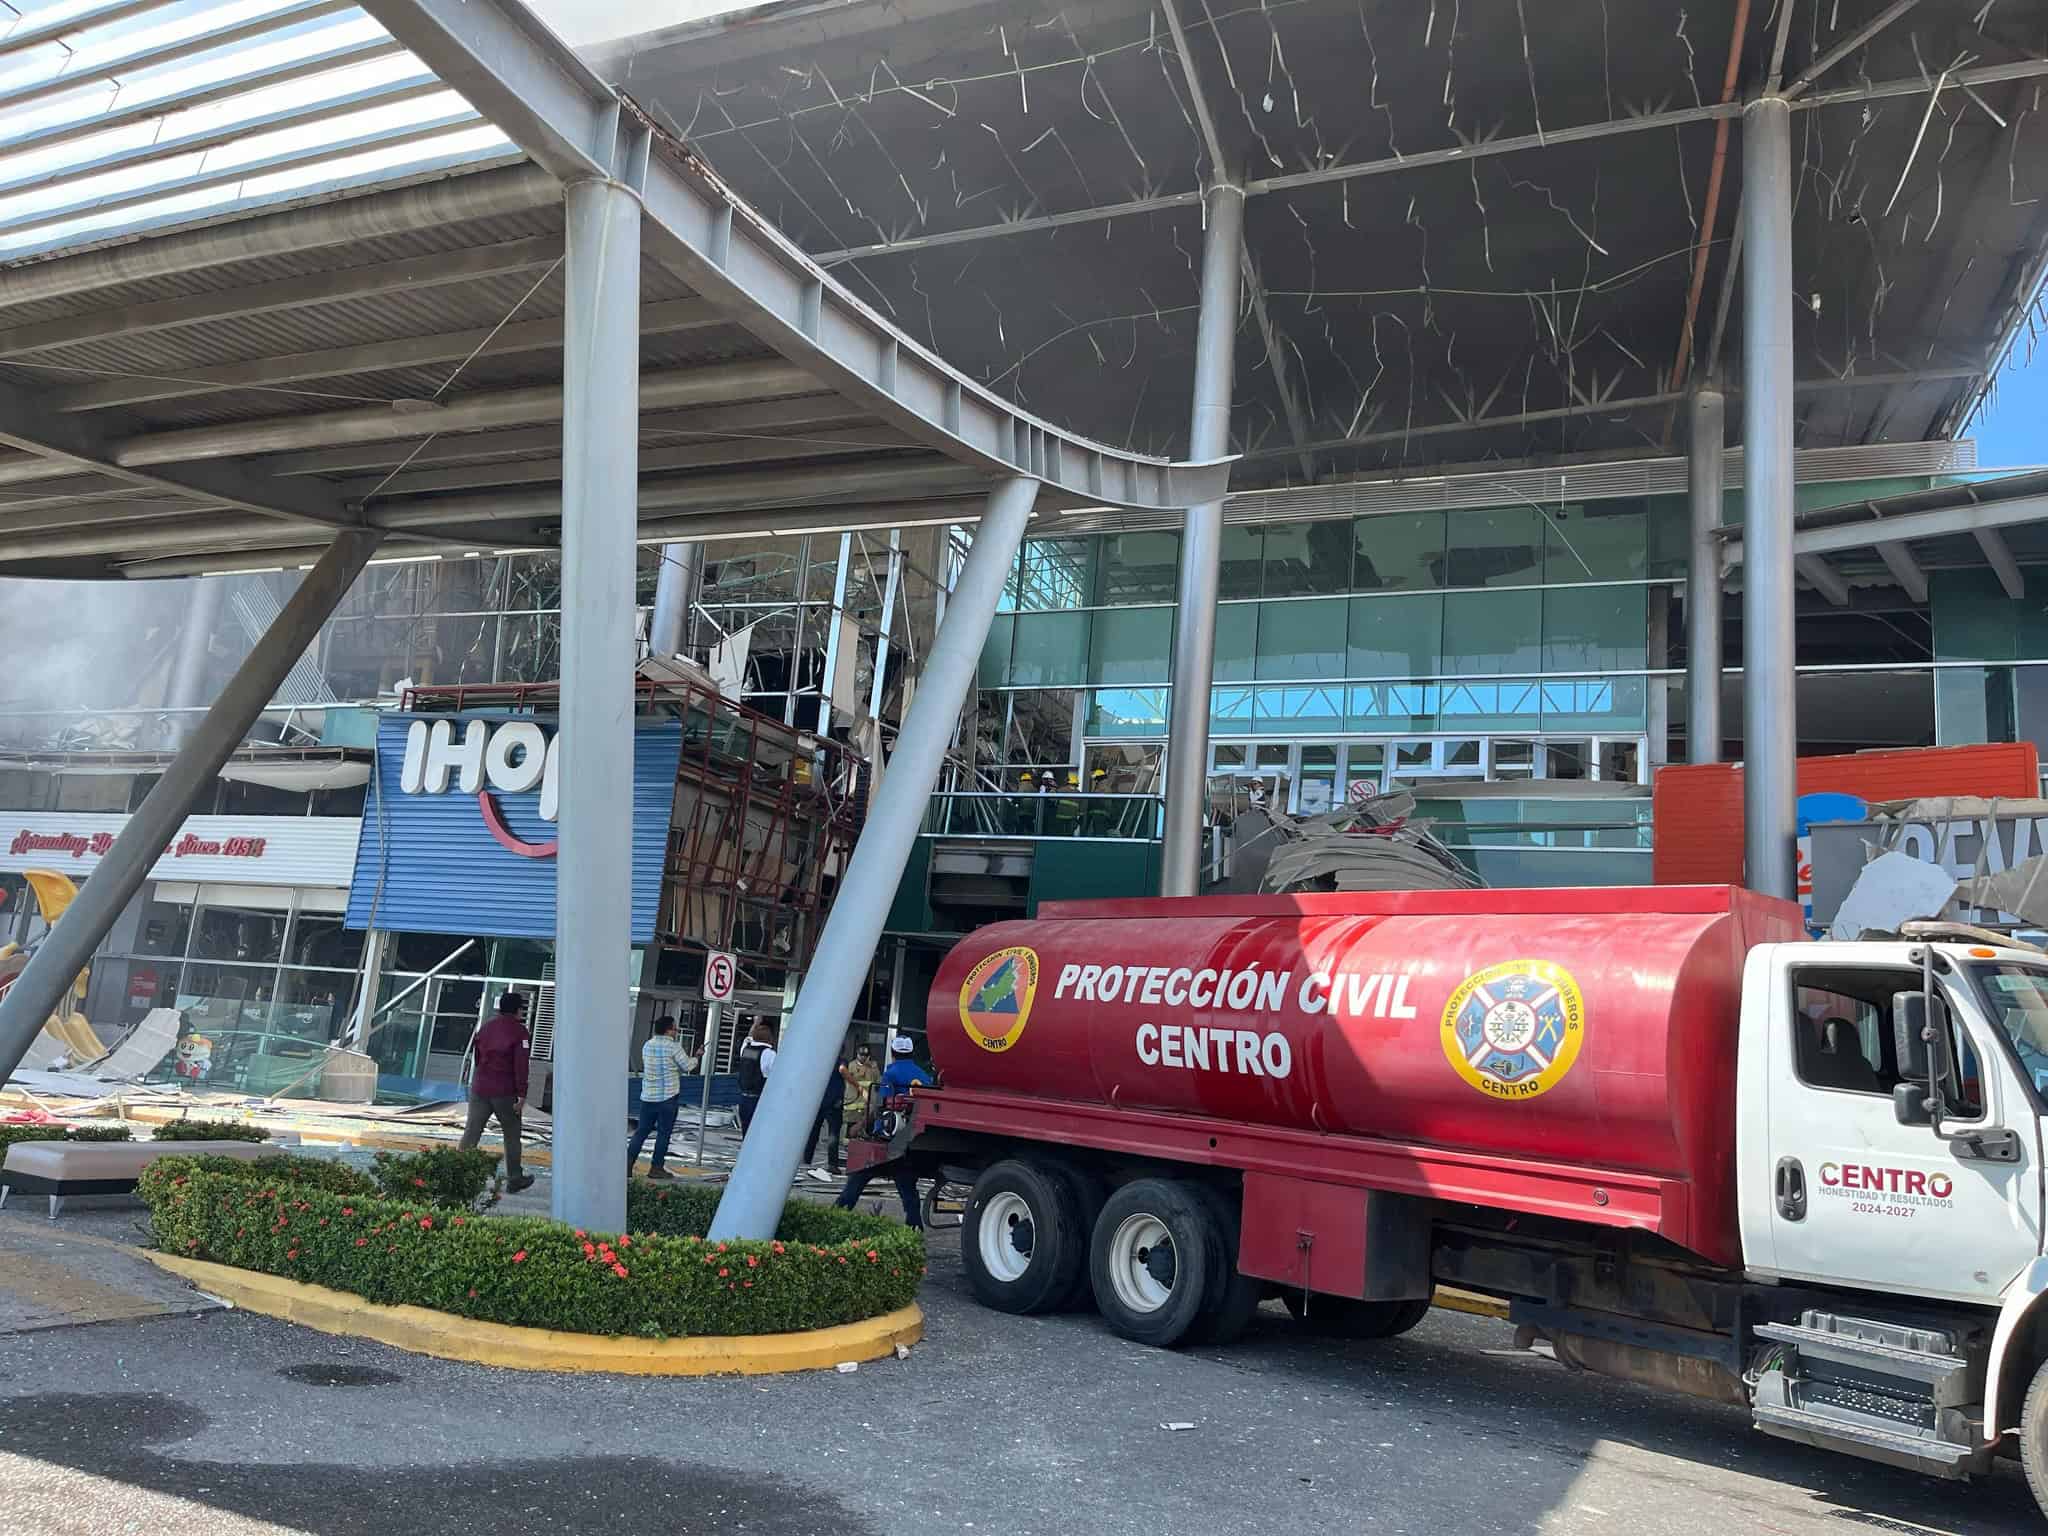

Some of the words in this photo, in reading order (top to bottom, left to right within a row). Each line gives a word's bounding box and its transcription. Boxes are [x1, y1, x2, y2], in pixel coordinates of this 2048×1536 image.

[715, 964, 727, 990] E
[1054, 961, 1290, 1012] PROTECCIÓN
[1299, 972, 1416, 1019] CIVIL
[982, 1037, 1007, 1049] CENTRO
[1136, 1023, 1292, 1079] CENTRO
[1481, 1079, 1539, 1096] CENTRO
[1818, 1161, 1953, 1199] CENTRO
[1818, 1185, 1879, 1200] HONESTIDAD
[1880, 1192, 1888, 1203] Y
[1889, 1193, 1953, 1209] RESULTADOS
[1851, 1202, 1916, 1218] 2024-2027
